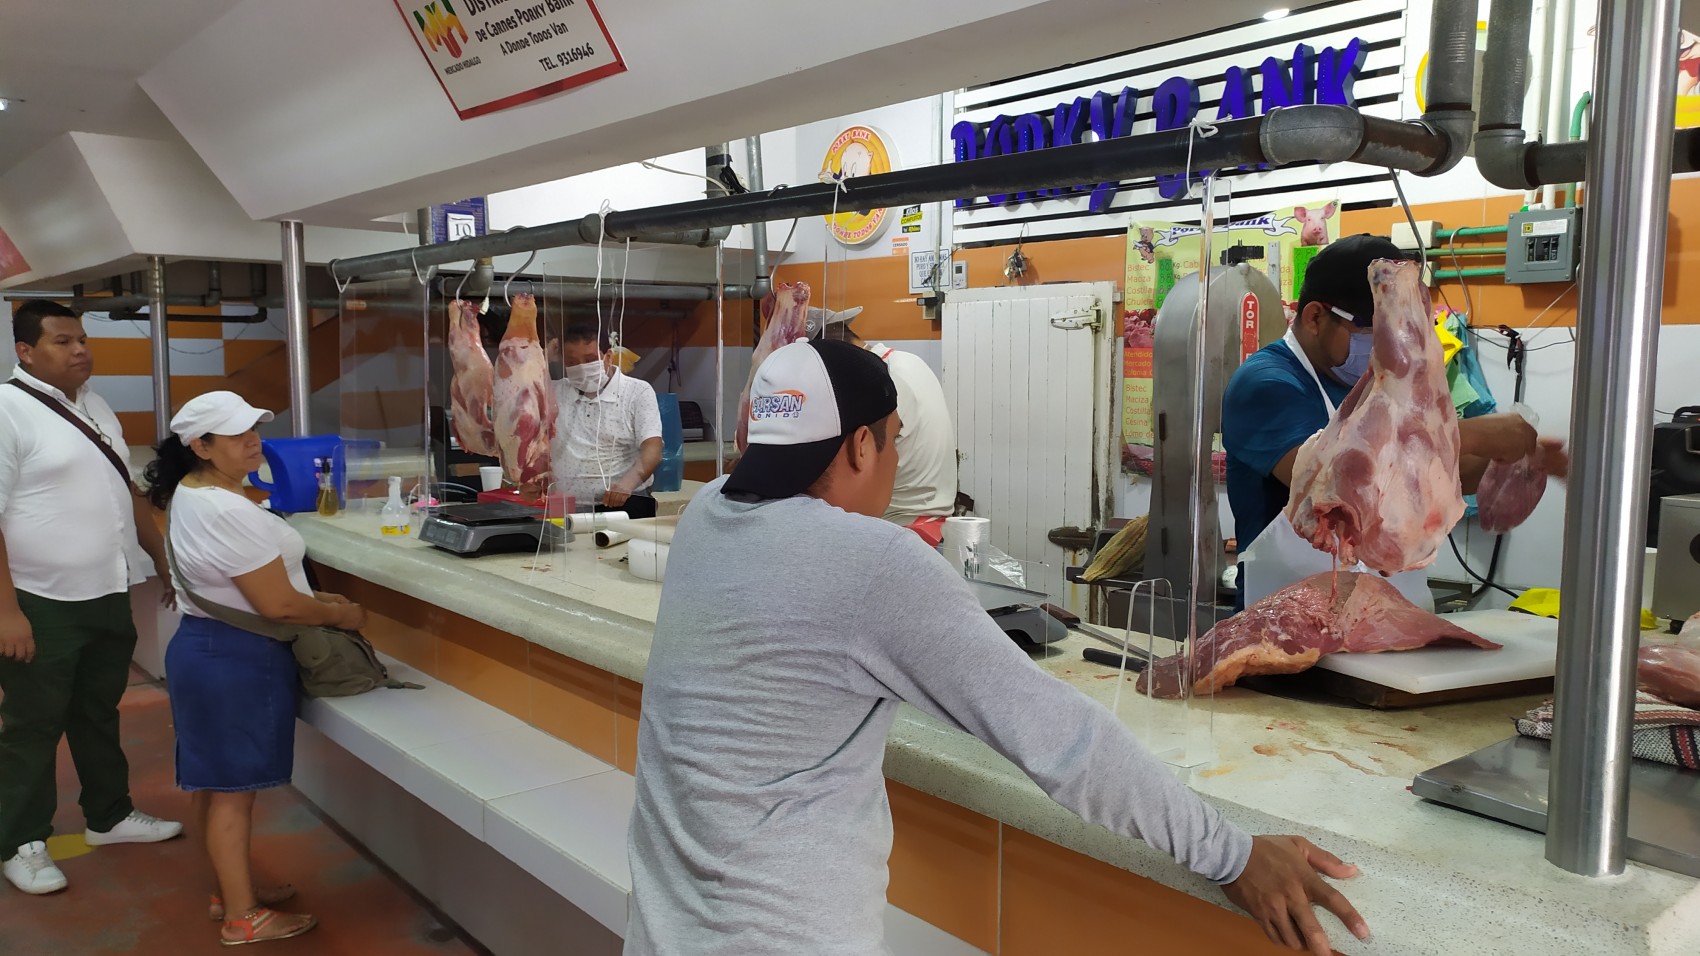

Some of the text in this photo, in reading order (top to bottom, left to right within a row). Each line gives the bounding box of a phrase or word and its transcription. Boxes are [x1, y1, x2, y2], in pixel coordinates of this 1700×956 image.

[538, 42, 595, 72] TEL. 9316946
[852, 129, 871, 142] BANK
[455, 223, 472, 239] 10
[1127, 264, 1150, 272] Bistec
[1126, 384, 1147, 392] Bistec
[1126, 396, 1149, 404] Maciza
